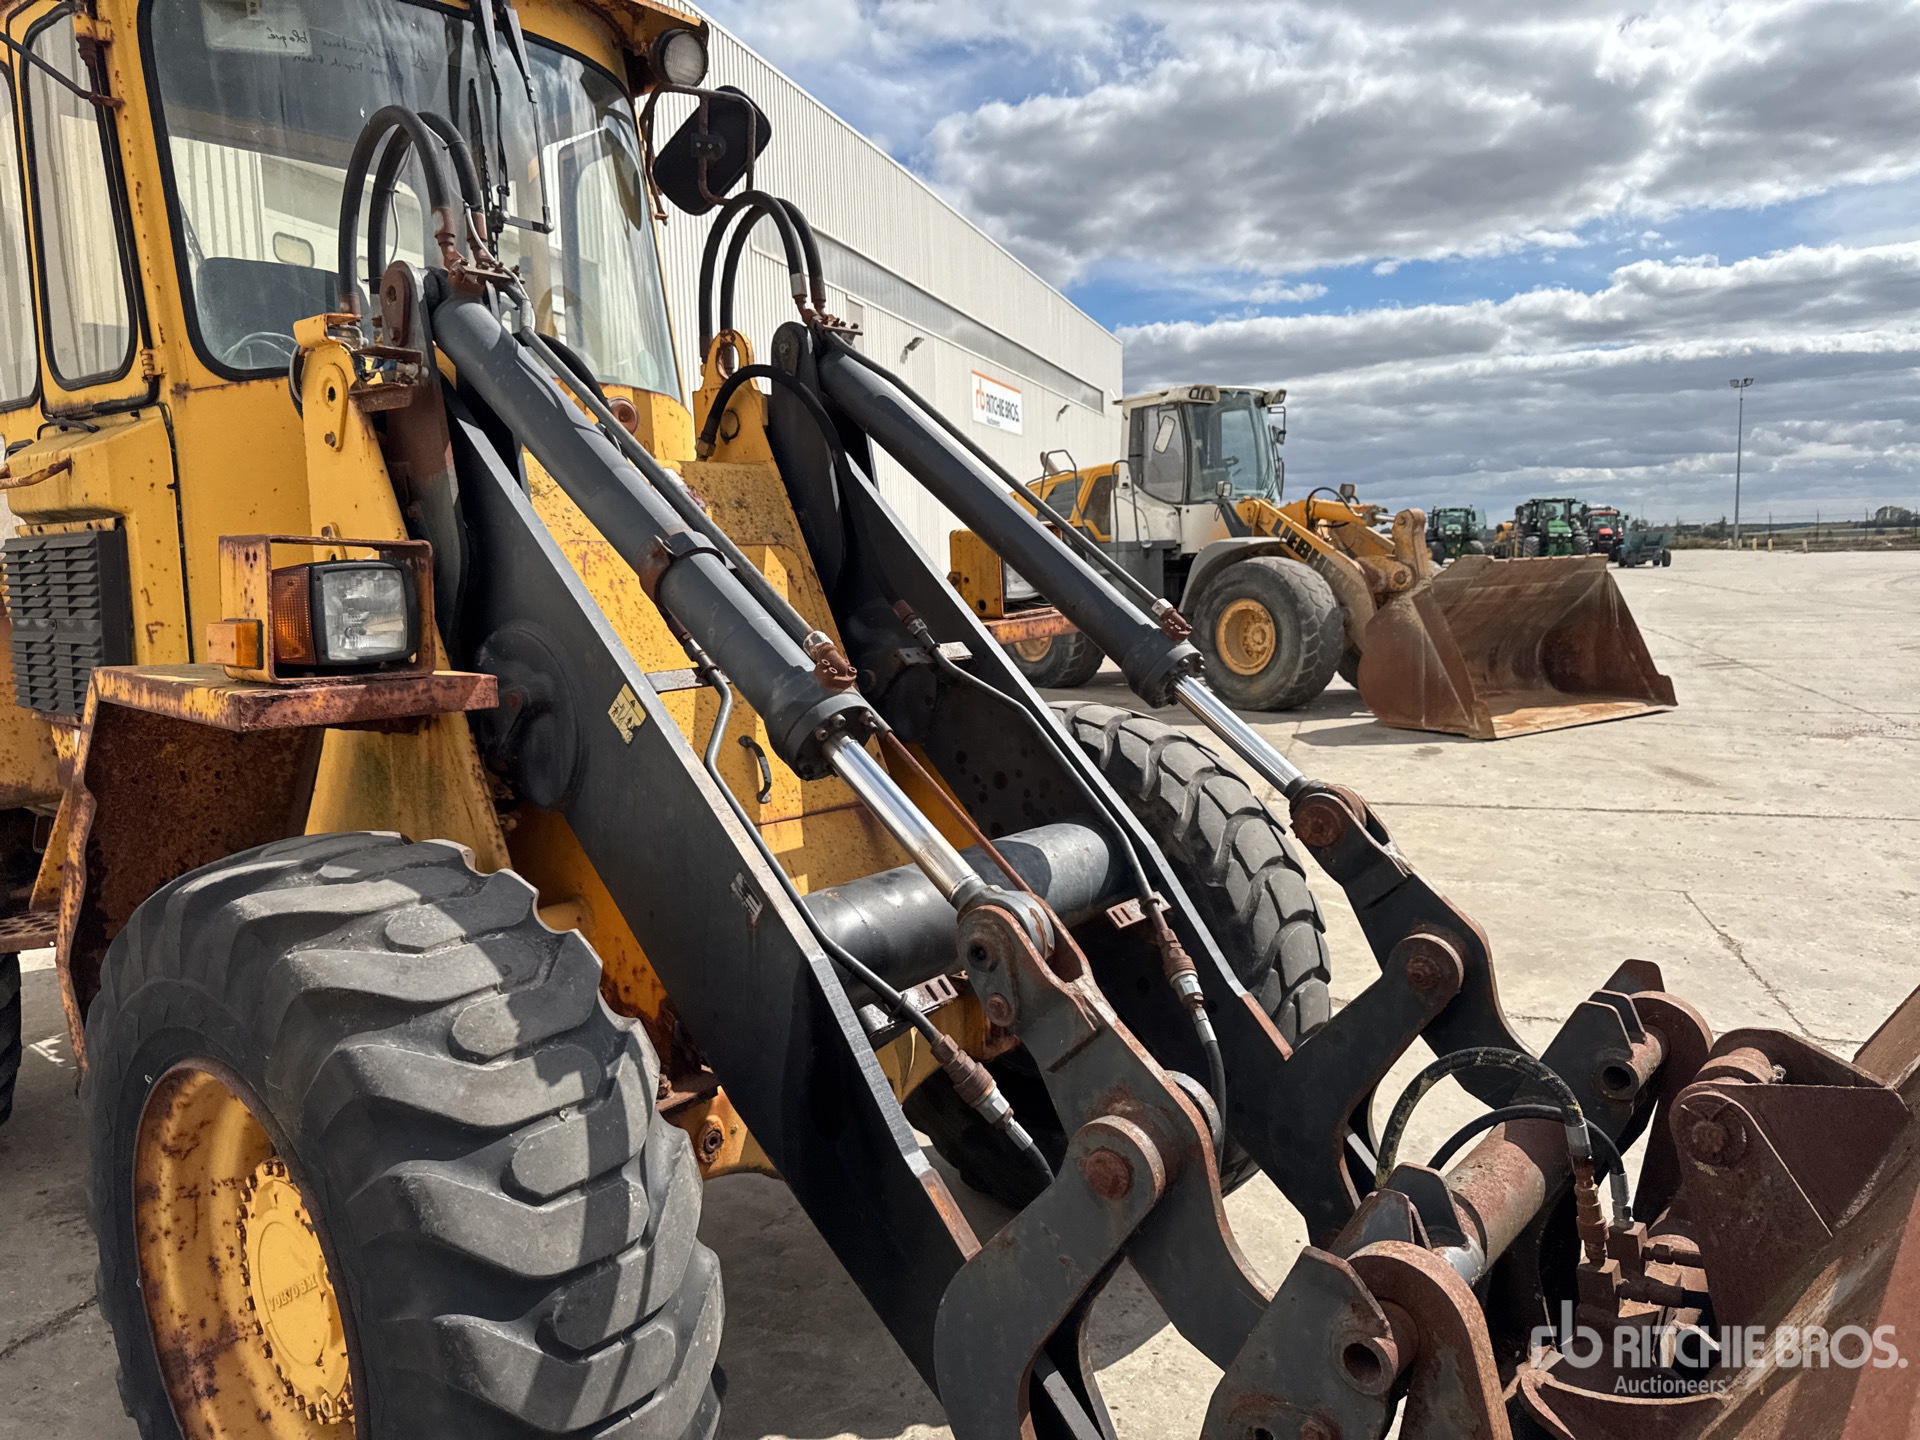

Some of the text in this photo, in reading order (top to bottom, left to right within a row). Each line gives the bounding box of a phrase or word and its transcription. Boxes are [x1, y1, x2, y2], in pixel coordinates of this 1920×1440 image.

[985, 393, 1005, 417] RITCHIE
[267, 1273, 318, 1312] VOLVO BM
